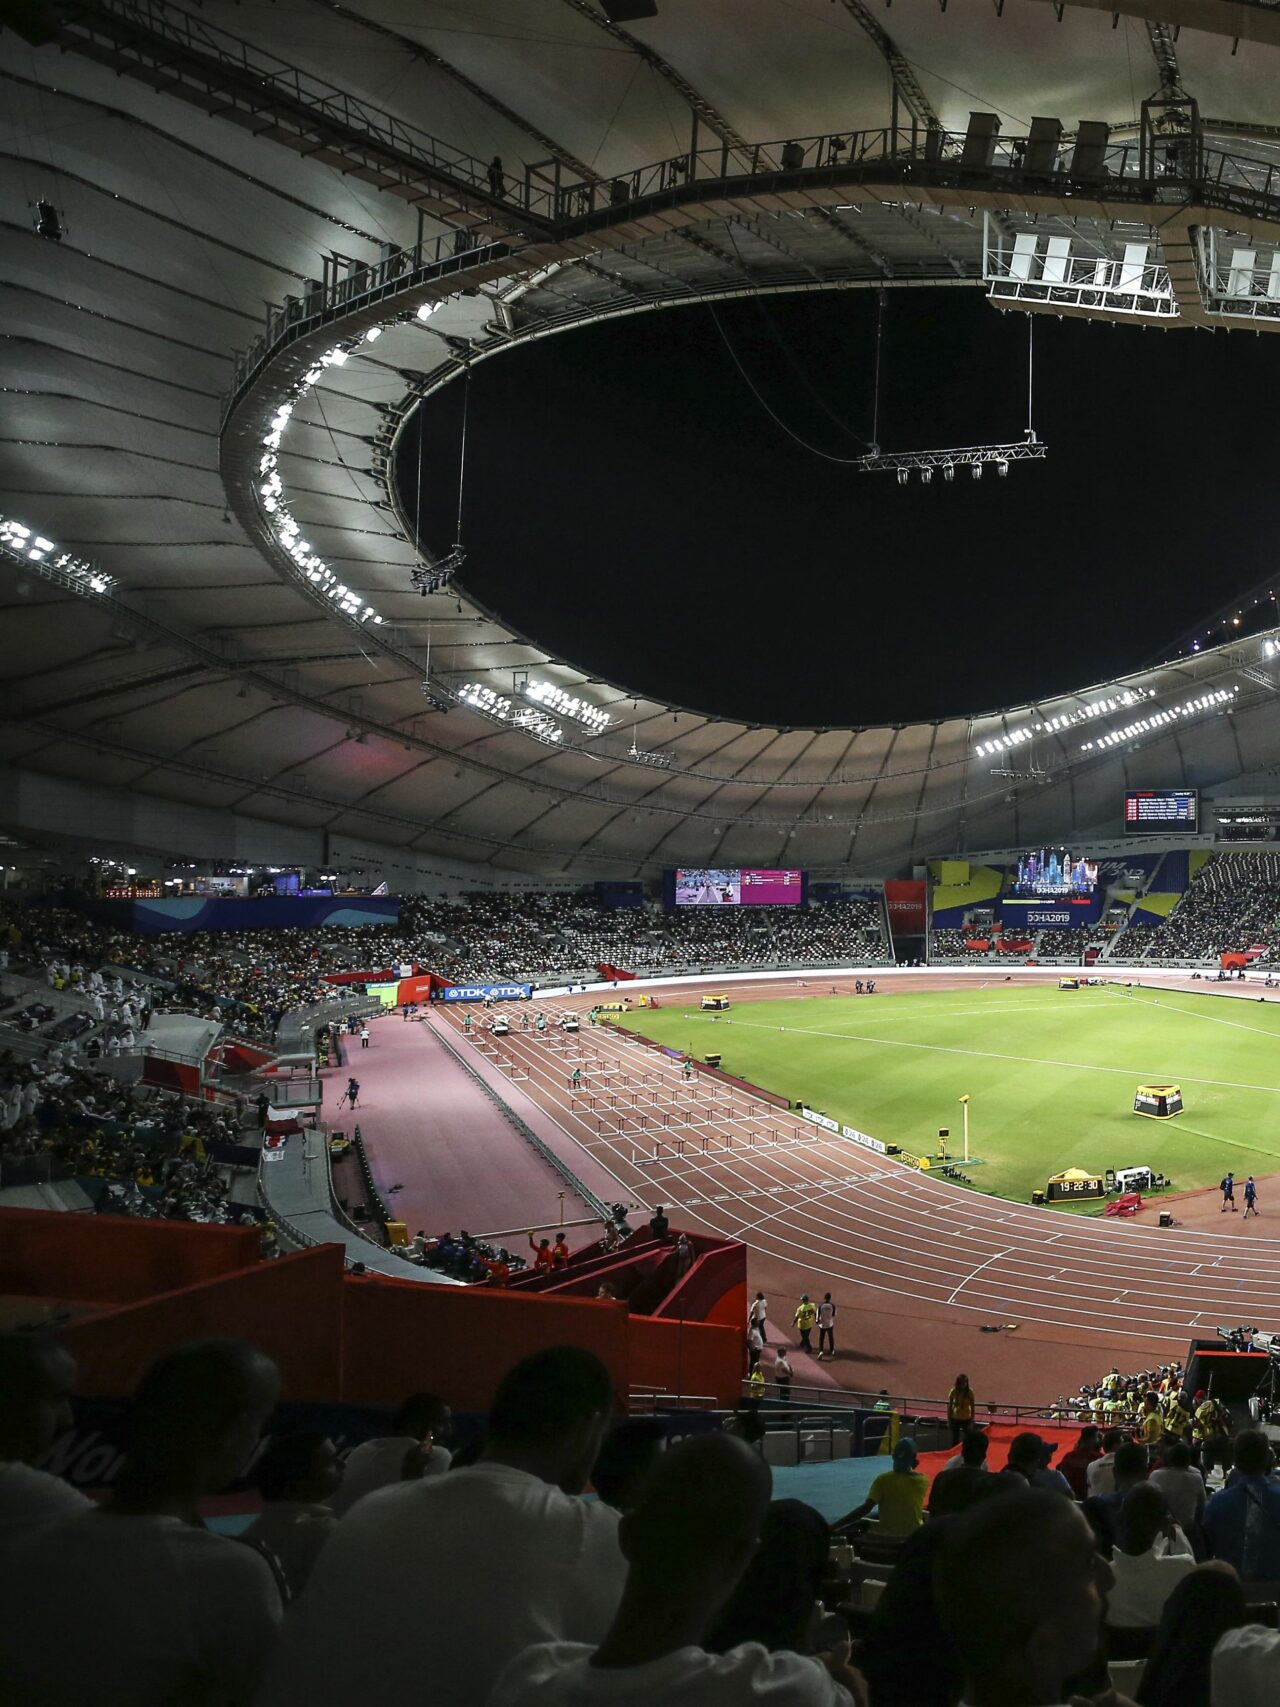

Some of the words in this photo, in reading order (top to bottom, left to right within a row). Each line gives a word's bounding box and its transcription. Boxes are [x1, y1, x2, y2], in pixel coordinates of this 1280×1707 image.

[1027, 914, 1070, 922] DOHA2019
[459, 988, 487, 997] TDK
[497, 986, 526, 996] TDK
[902, 1152, 920, 1167] SEIKO
[1060, 1180, 1098, 1192] 19:22:30
